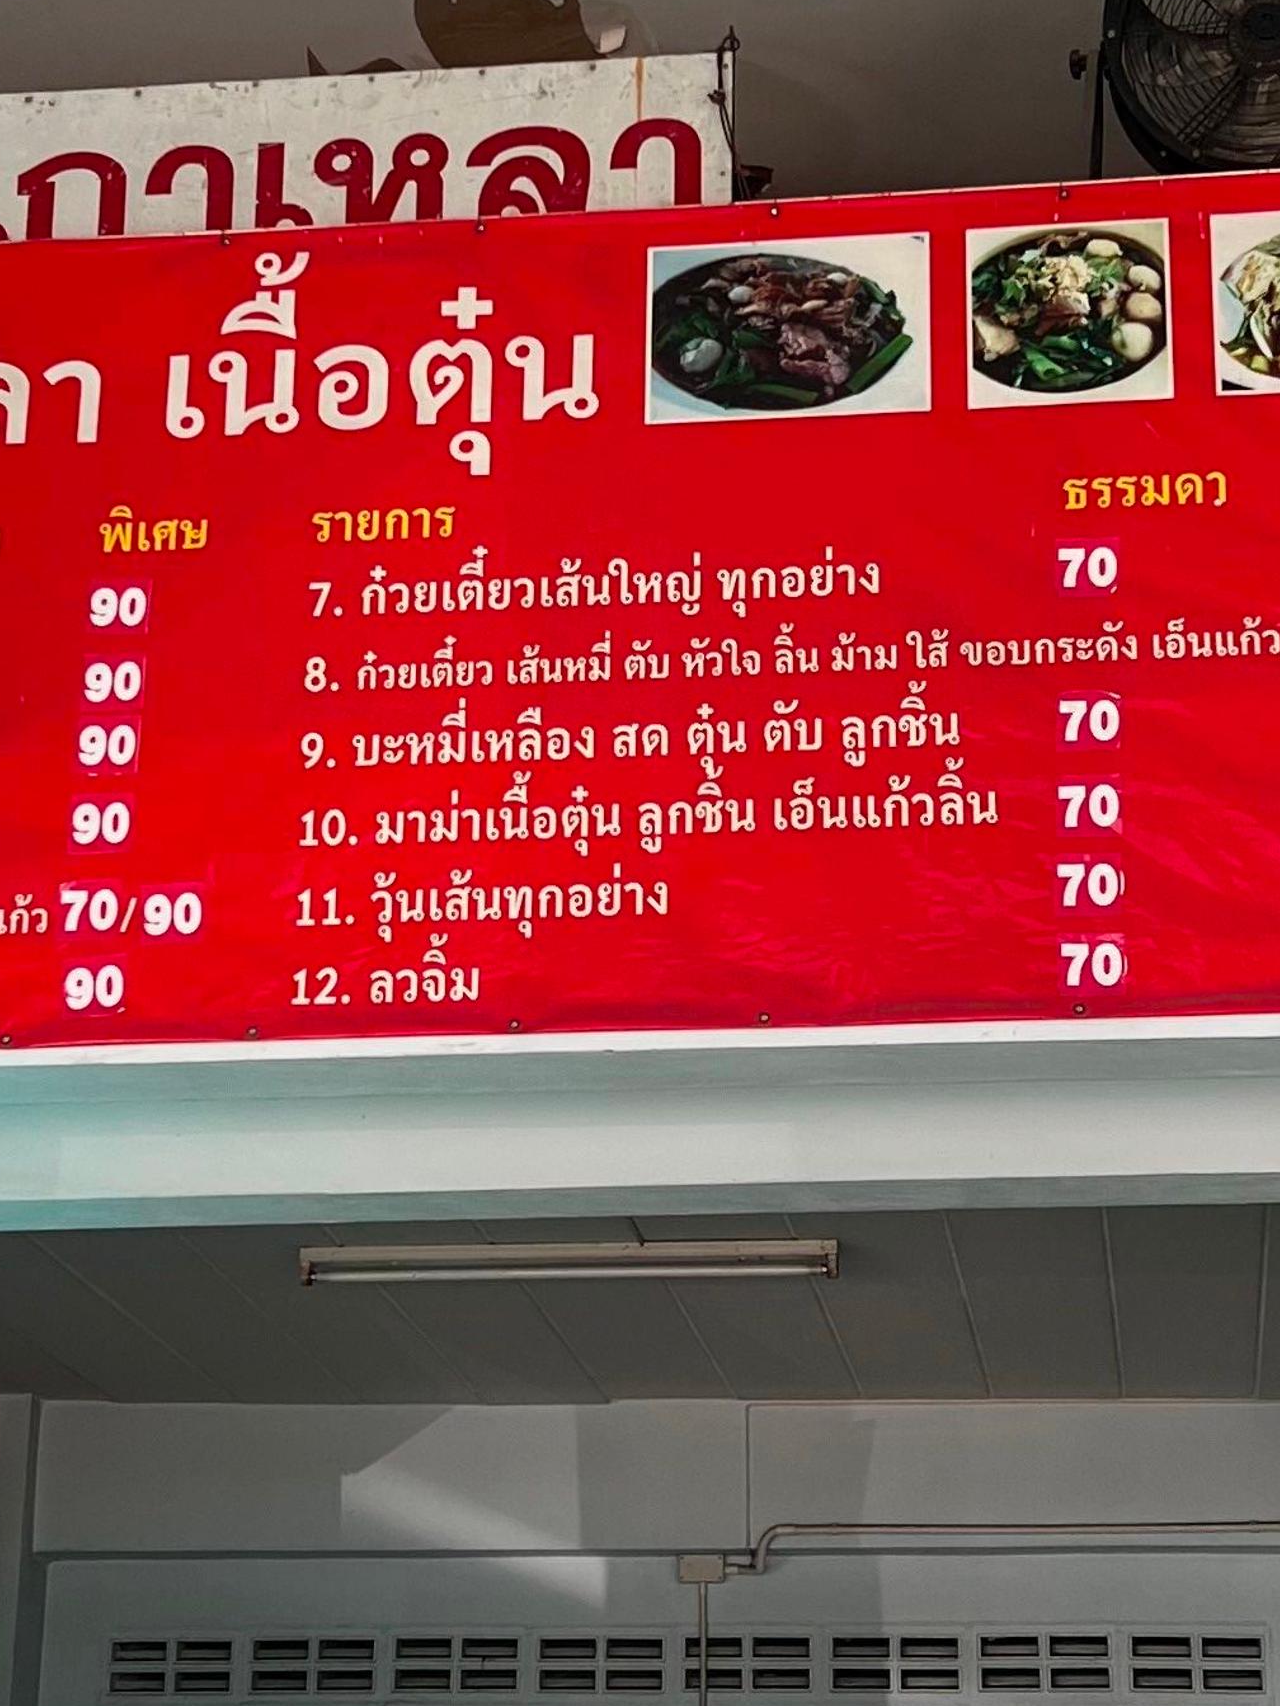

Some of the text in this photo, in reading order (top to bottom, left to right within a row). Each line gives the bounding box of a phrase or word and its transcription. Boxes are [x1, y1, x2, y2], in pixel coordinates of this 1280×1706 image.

[165, 251, 600, 476] เนื้อตุ๋น
[99, 505, 208, 553] พิเศษ
[312, 506, 456, 542] รายการ
[1062, 471, 1227, 510] ธรรมดา
[89, 587, 147, 627] 90
[308, 581, 343, 617] 7.
[361, 545, 702, 616] ก๋วยเตี๋ยวเส้นใหญ่
[716, 546, 880, 618] ทุกอย่าง
[1057, 546, 1118, 588] 70
[84, 661, 142, 703] 90
[304, 656, 340, 693] 8.
[357, 635, 493, 690] ก๋วยเตี๋ยว
[507, 630, 611, 685] เส้นหมี่
[624, 639, 670, 680] ตับ
[681, 637, 761, 678] หัวใจ
[773, 622, 819, 674] ลิ้น
[831, 632, 897, 672] ม้าม
[1152, 616, 1280, 659] เอ็นแก้ว
[78, 724, 136, 766] 90
[301, 732, 336, 769] 9.
[352, 697, 595, 767] บะหมี่เหลือง
[612, 723, 669, 758] สด
[686, 703, 747, 771] ตุ๋น
[763, 699, 822, 752] ตับ
[841, 680, 964, 771] ลูกชิ้น
[1058, 699, 1120, 742] 70
[72, 801, 130, 845] 90
[299, 808, 358, 847] 10.
[375, 770, 621, 857] มาม่าเนื้อตุ๋น
[637, 763, 756, 853] ลูกชิ้น
[773, 756, 999, 831] เอ็นแก้วลิ้น
[1057, 784, 1120, 828] 70
[296, 888, 355, 927] 11.
[370, 862, 668, 943] วุ้นเส้นทุกอย่าง
[1056, 863, 1119, 907] 70
[64, 964, 125, 1013] 90
[291, 966, 351, 1005] 12.
[370, 933, 480, 1004] ลวจิ้ม
[1060, 942, 1123, 987] 70
